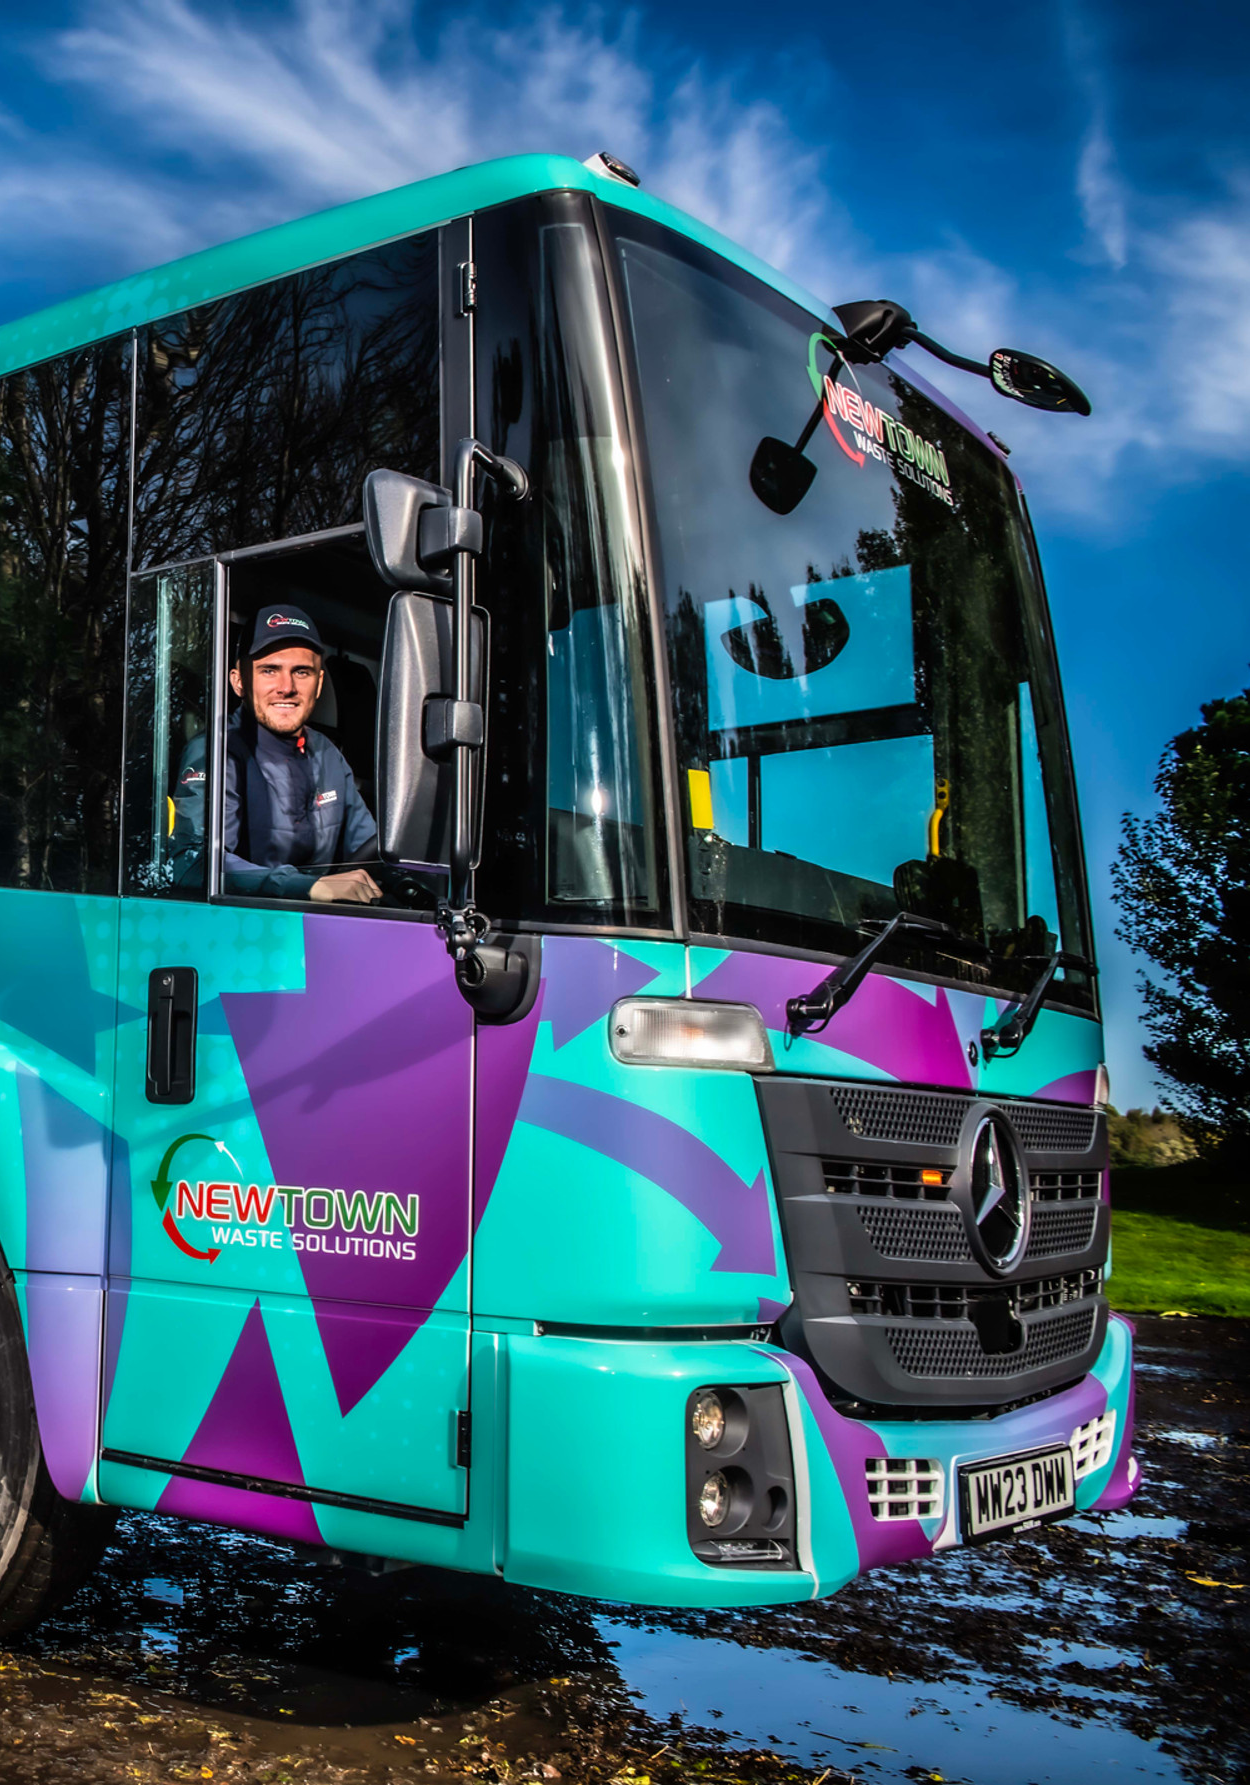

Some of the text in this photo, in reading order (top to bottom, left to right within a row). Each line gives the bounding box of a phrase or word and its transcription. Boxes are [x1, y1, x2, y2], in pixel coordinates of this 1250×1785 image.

[823, 375, 950, 487] NEWTOWN
[853, 430, 954, 506] WASTE SOLUTIONS
[175, 1180, 420, 1237] NEWTOWN
[211, 1226, 417, 1261] WASTE SOLUTIONS
[975, 1456, 1067, 1525] MW23 DWM
